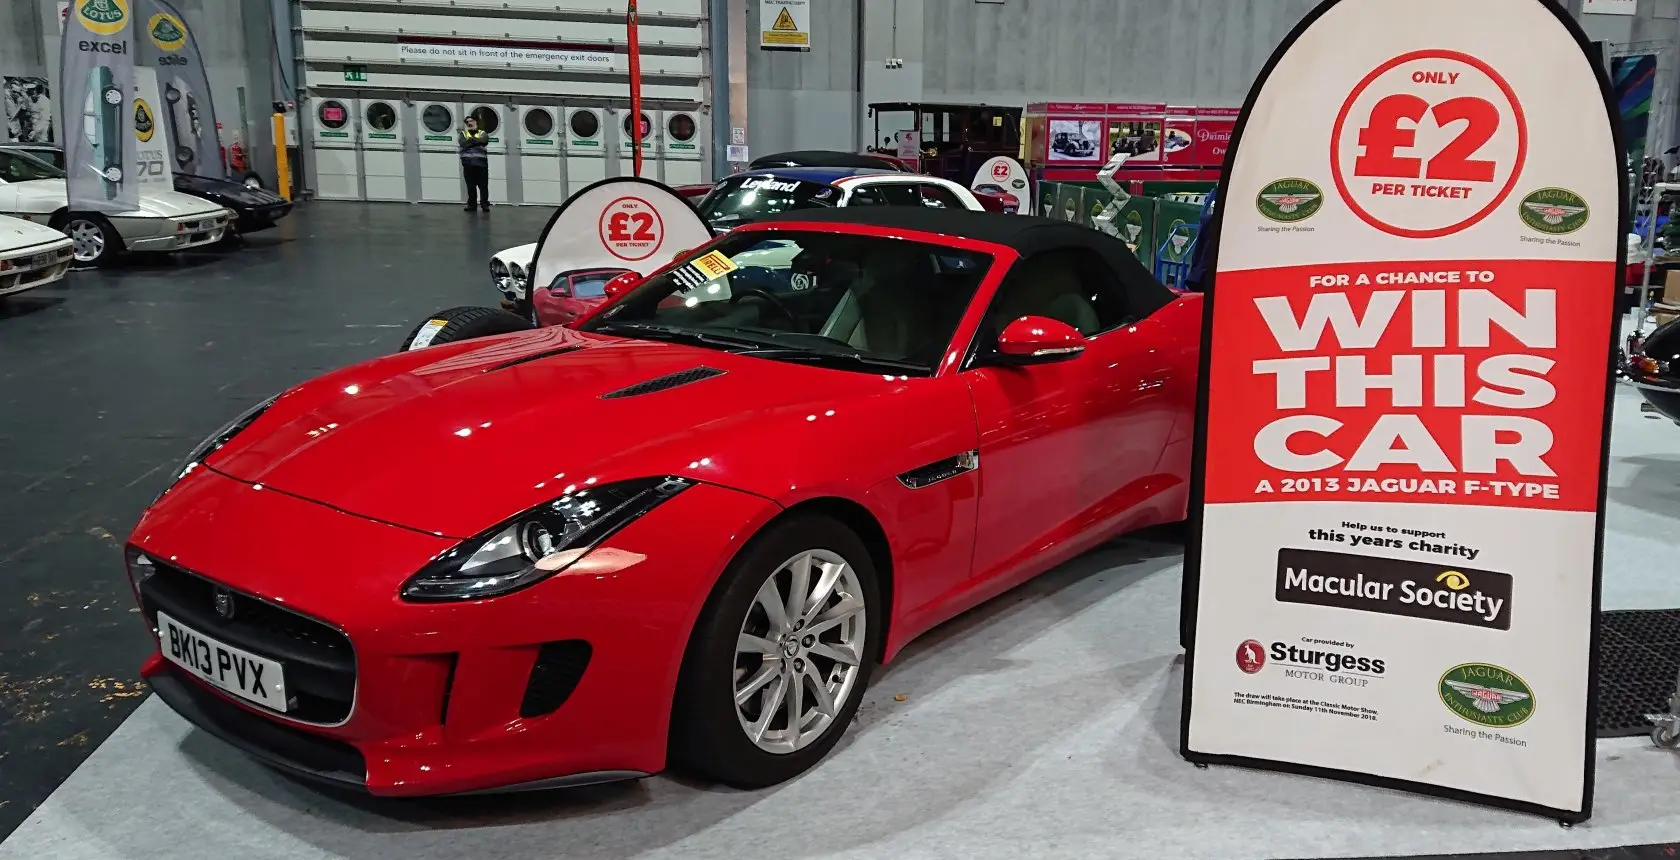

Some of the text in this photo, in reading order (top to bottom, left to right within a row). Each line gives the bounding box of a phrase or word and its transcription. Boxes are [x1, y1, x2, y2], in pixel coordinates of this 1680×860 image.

[82, 6, 122, 21] LOTUS
[79, 40, 127, 55] excel
[401, 46, 427, 54] Please
[458, 48, 468, 56] sit
[510, 51, 524, 59] the
[525, 53, 569, 62] emergency
[570, 53, 585, 61] exit
[1412, 71, 1460, 85] ONLY
[1197, 129, 1231, 142] Daimle
[1354, 93, 1500, 182] £2
[993, 165, 1008, 176] £2
[740, 178, 801, 193] Leyland
[1273, 180, 1310, 192] JAGUAR
[1372, 182, 1472, 199] PER TICKET
[1536, 190, 1576, 203] JAGUAR
[608, 212, 655, 241] £2
[1519, 235, 1581, 247] Sharing the Passion
[1310, 270, 1495, 288] FOR A CHANCE TO
[1253, 288, 1557, 352] WIN
[1253, 354, 1557, 409] THIS
[1253, 414, 1558, 477] CAR
[1254, 477, 1560, 500] A 2013 JAGUAR F-TYPE
[1341, 521, 1446, 539] Help us to support
[1308, 529, 1480, 561] this years charity
[1284, 566, 1504, 622] Macular Society
[1313, 639, 1345, 647] provided
[1345, 641, 1355, 649] by
[167, 622, 268, 699] BK13 PVX
[1270, 641, 1386, 674] Sturgess
[1285, 669, 1369, 688] MOTOR GROUP
[1461, 666, 1514, 686] JAGUAR
[1471, 688, 1503, 701] JAGUAR
[1246, 699, 1282, 708] Birmingham
[1291, 703, 1313, 712] Sunday
[1314, 705, 1328, 713] 11th
[1328, 708, 1360, 718] November
[1360, 713, 1378, 721] 2018.
[1285, 696, 1302, 704] place
[1320, 701, 1341, 709] Classic
[1341, 704, 1360, 712] Motor
[1360, 707, 1379, 715] Show.
[1507, 706, 1529, 722] CLUB
[1443, 724, 1527, 747] Sharing the Passion
